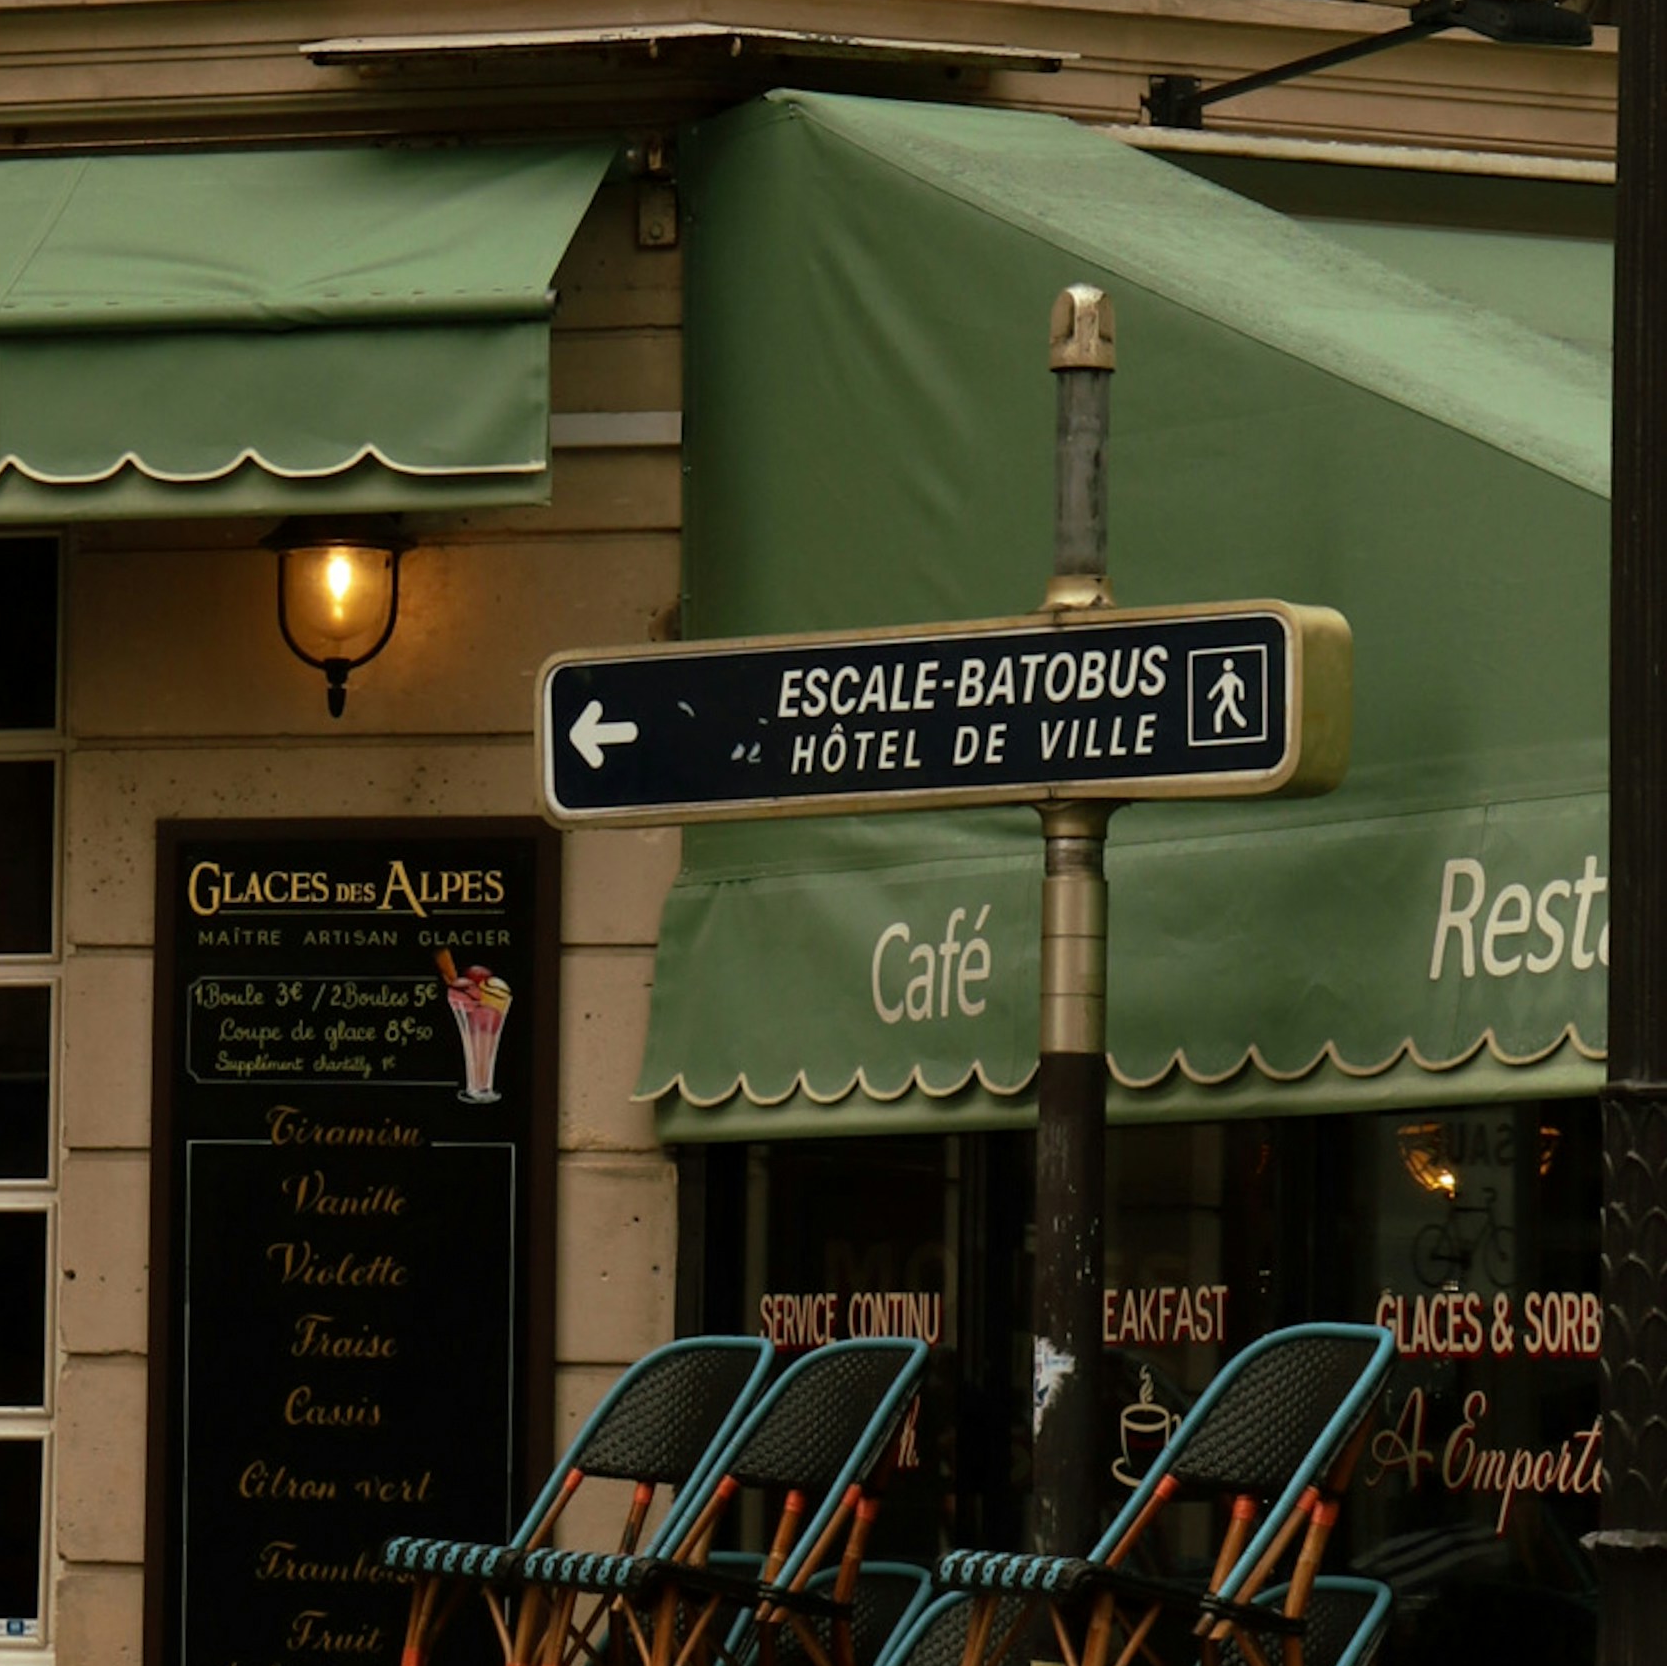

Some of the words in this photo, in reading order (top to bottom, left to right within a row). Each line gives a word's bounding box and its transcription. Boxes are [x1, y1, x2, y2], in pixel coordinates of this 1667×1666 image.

[777, 644, 1169, 719] ESCALE-BATOBUS
[790, 724, 922, 775] HÔTEL
[952, 723, 1006, 767] DE
[1039, 712, 1158, 762] VILLE
[187, 861, 330, 918] GLACES
[336, 881, 376, 904] DES
[377, 859, 505, 918] ALPES
[302, 930, 398, 946] ARTISAN
[418, 929, 511, 946] GLACIER
[871, 904, 991, 1025] Café
[265, 1104, 425, 1149] Tiramisu
[281, 1169, 407, 1216] Vanille
[267, 1241, 410, 1288] Violette
[290, 1313, 399, 1360] Fraise
[760, 1293, 837, 1347] SERVICE
[847, 1291, 942, 1345] CONTINU
[1102, 1285, 1229, 1343] EAKFAST
[1376, 1291, 1482, 1356] GLACES
[1490, 1292, 1516, 1355] &
[1524, 1290, 1603, 1356] SORB
[283, 1385, 383, 1427] Cassis
[240, 1460, 337, 1502] Citron
[355, 1471, 432, 1502] vert
[1443, 1389, 1602, 1537] Emport
[286, 1609, 384, 1653] Fruit
